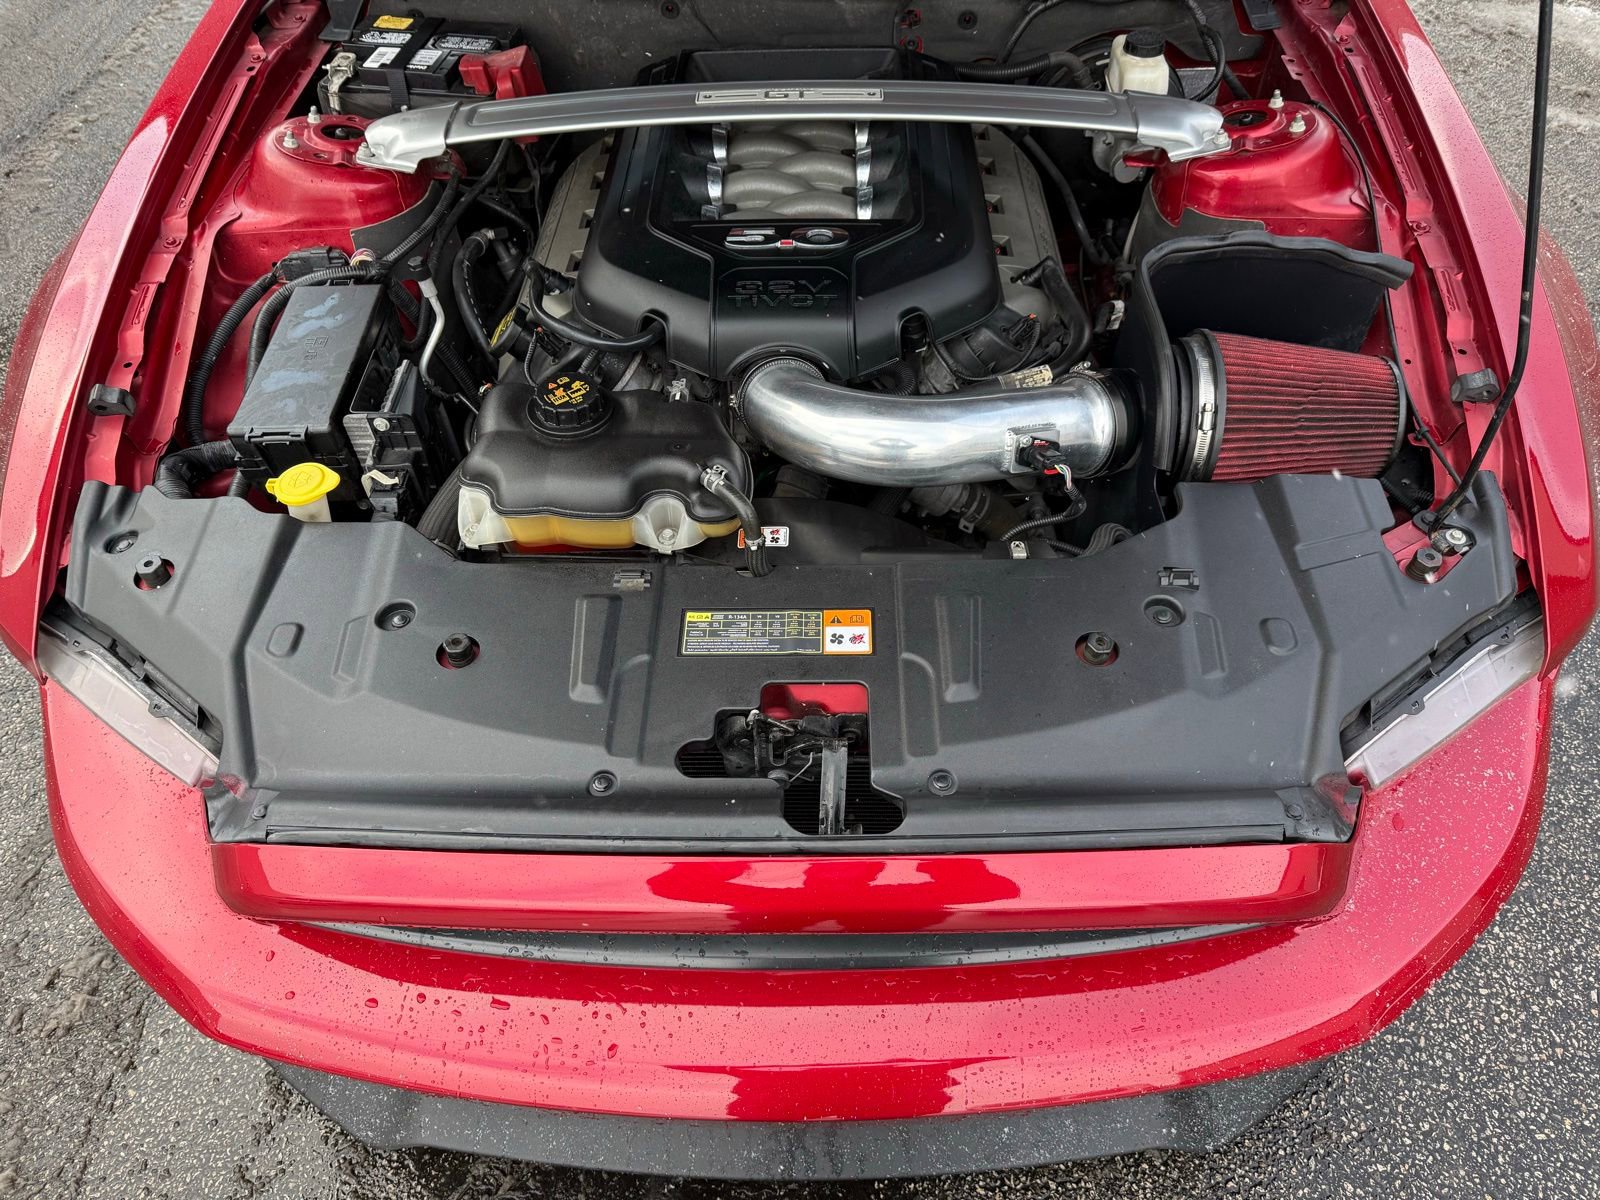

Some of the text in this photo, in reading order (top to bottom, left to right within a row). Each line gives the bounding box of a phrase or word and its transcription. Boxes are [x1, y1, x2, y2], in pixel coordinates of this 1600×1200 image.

[763, 89, 815, 99] GT
[724, 227, 849, 249] 5.0
[735, 279, 832, 294] 32V
